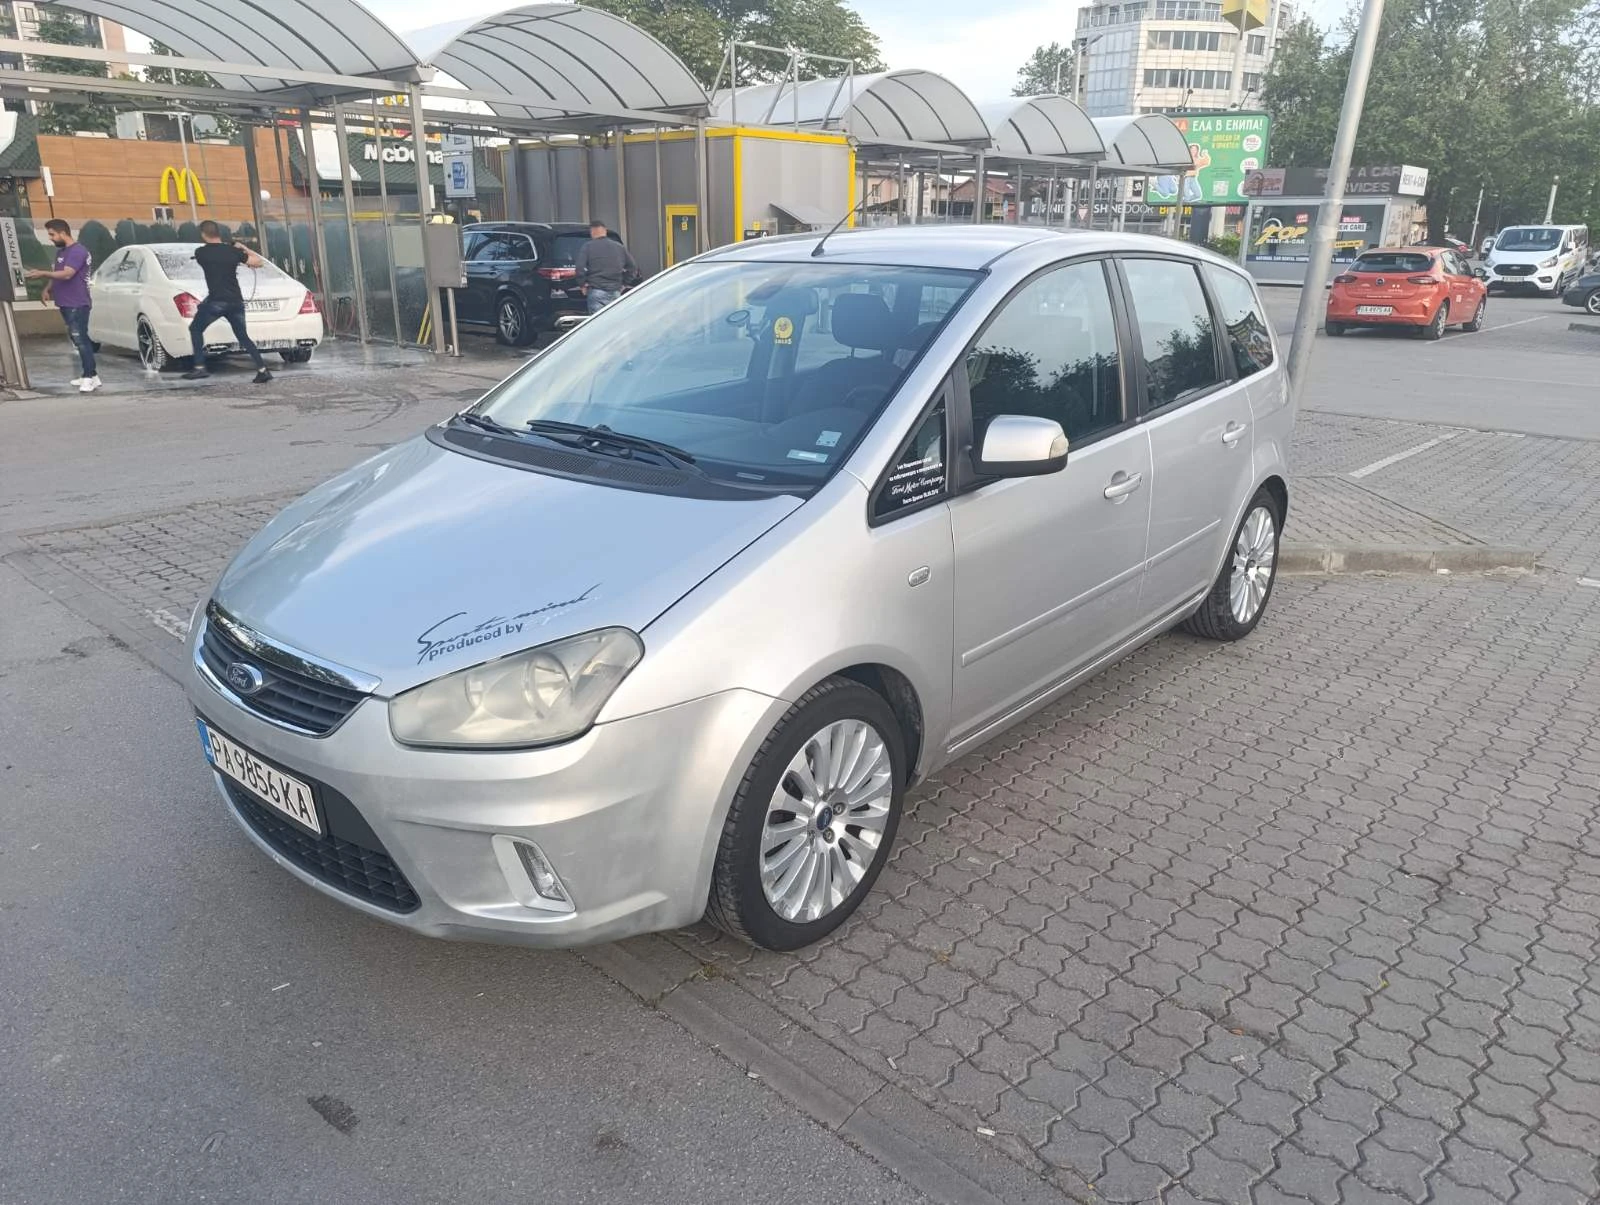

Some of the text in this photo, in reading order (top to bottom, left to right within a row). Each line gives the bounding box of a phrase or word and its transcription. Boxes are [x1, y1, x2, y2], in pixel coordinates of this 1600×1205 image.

[1192, 120, 1212, 132] ЕЛА
[1215, 119, 1222, 131] В
[1225, 119, 1263, 131] ЕКИПА!
[428, 622, 524, 661] produced by
